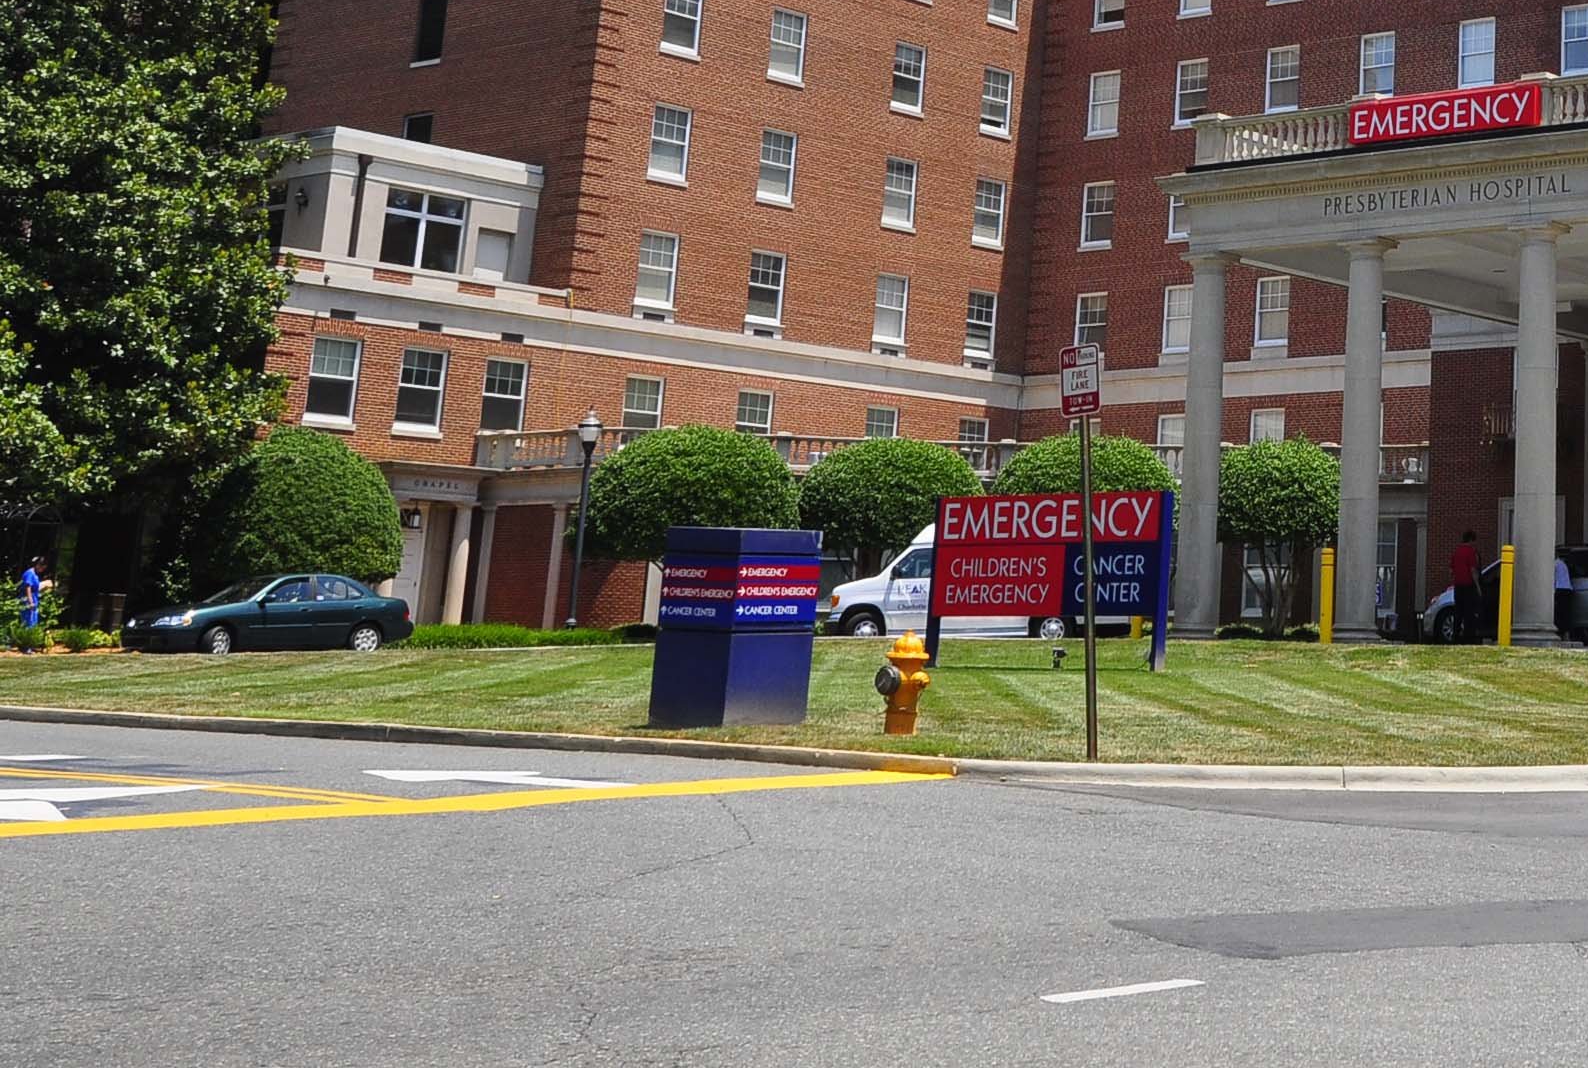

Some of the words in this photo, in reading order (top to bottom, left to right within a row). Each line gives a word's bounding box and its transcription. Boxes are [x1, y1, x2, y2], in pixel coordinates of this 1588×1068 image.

[1353, 91, 1530, 140] EMERGENCY
[1323, 185, 1457, 217] PRESBYTERIAN
[1469, 174, 1571, 202] HOSPITAL
[1063, 353, 1075, 365] NO
[1071, 370, 1089, 381] FIRE
[1071, 380, 1089, 391] LANE
[943, 497, 1153, 540] EMERGENCY
[671, 568, 708, 578] EMERGENCY
[747, 567, 788, 578] EMERGENCY
[950, 557, 1047, 578] CHILDREN'S
[701, 588, 734, 599] EMERGENCY
[781, 586, 817, 596] EMERGENCY
[946, 584, 1049, 604] EMERGENCY
[1074, 581, 1140, 603] CNTER
[667, 605, 692, 615] CANCER
[694, 607, 716, 617] CENTER
[744, 605, 772, 615] CANCER
[773, 605, 798, 615] CENTER
